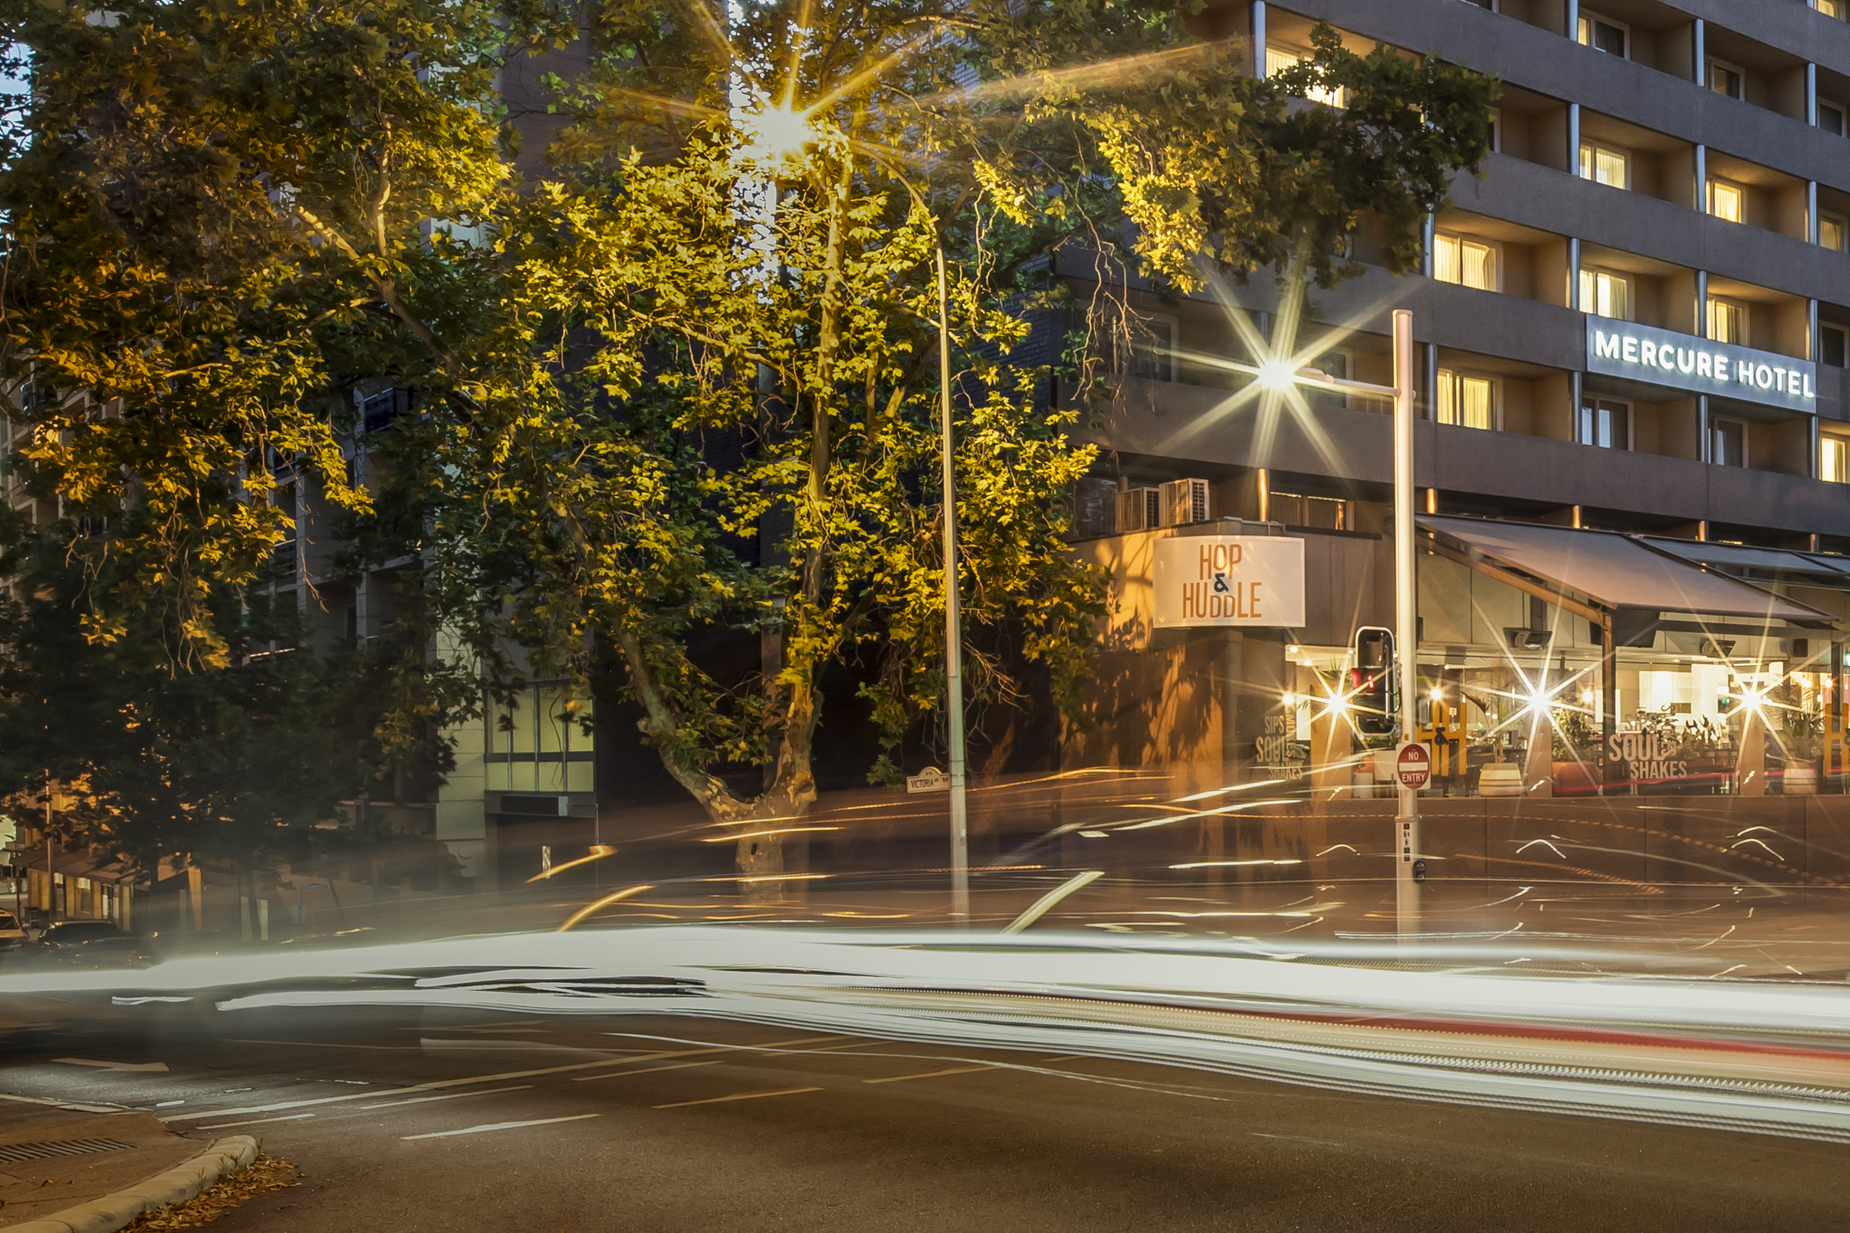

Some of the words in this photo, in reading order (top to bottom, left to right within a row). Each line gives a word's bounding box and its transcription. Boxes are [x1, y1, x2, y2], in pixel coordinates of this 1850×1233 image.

[1595, 330, 1729, 381] MERCURE
[1738, 360, 1815, 398] HOTEL
[1199, 544, 1242, 580] HOP
[1214, 573, 1229, 592] &
[1182, 581, 1262, 619] HUDDLE
[1264, 715, 1285, 734] SIPS
[1256, 736, 1289, 763] SOUL
[1408, 751, 1419, 761] NO
[1608, 733, 1666, 762] SOUL
[1401, 772, 1426, 783] ENTRY
[1630, 760, 1688, 779] SHAKES
[910, 778, 934, 789] VICTORIA
